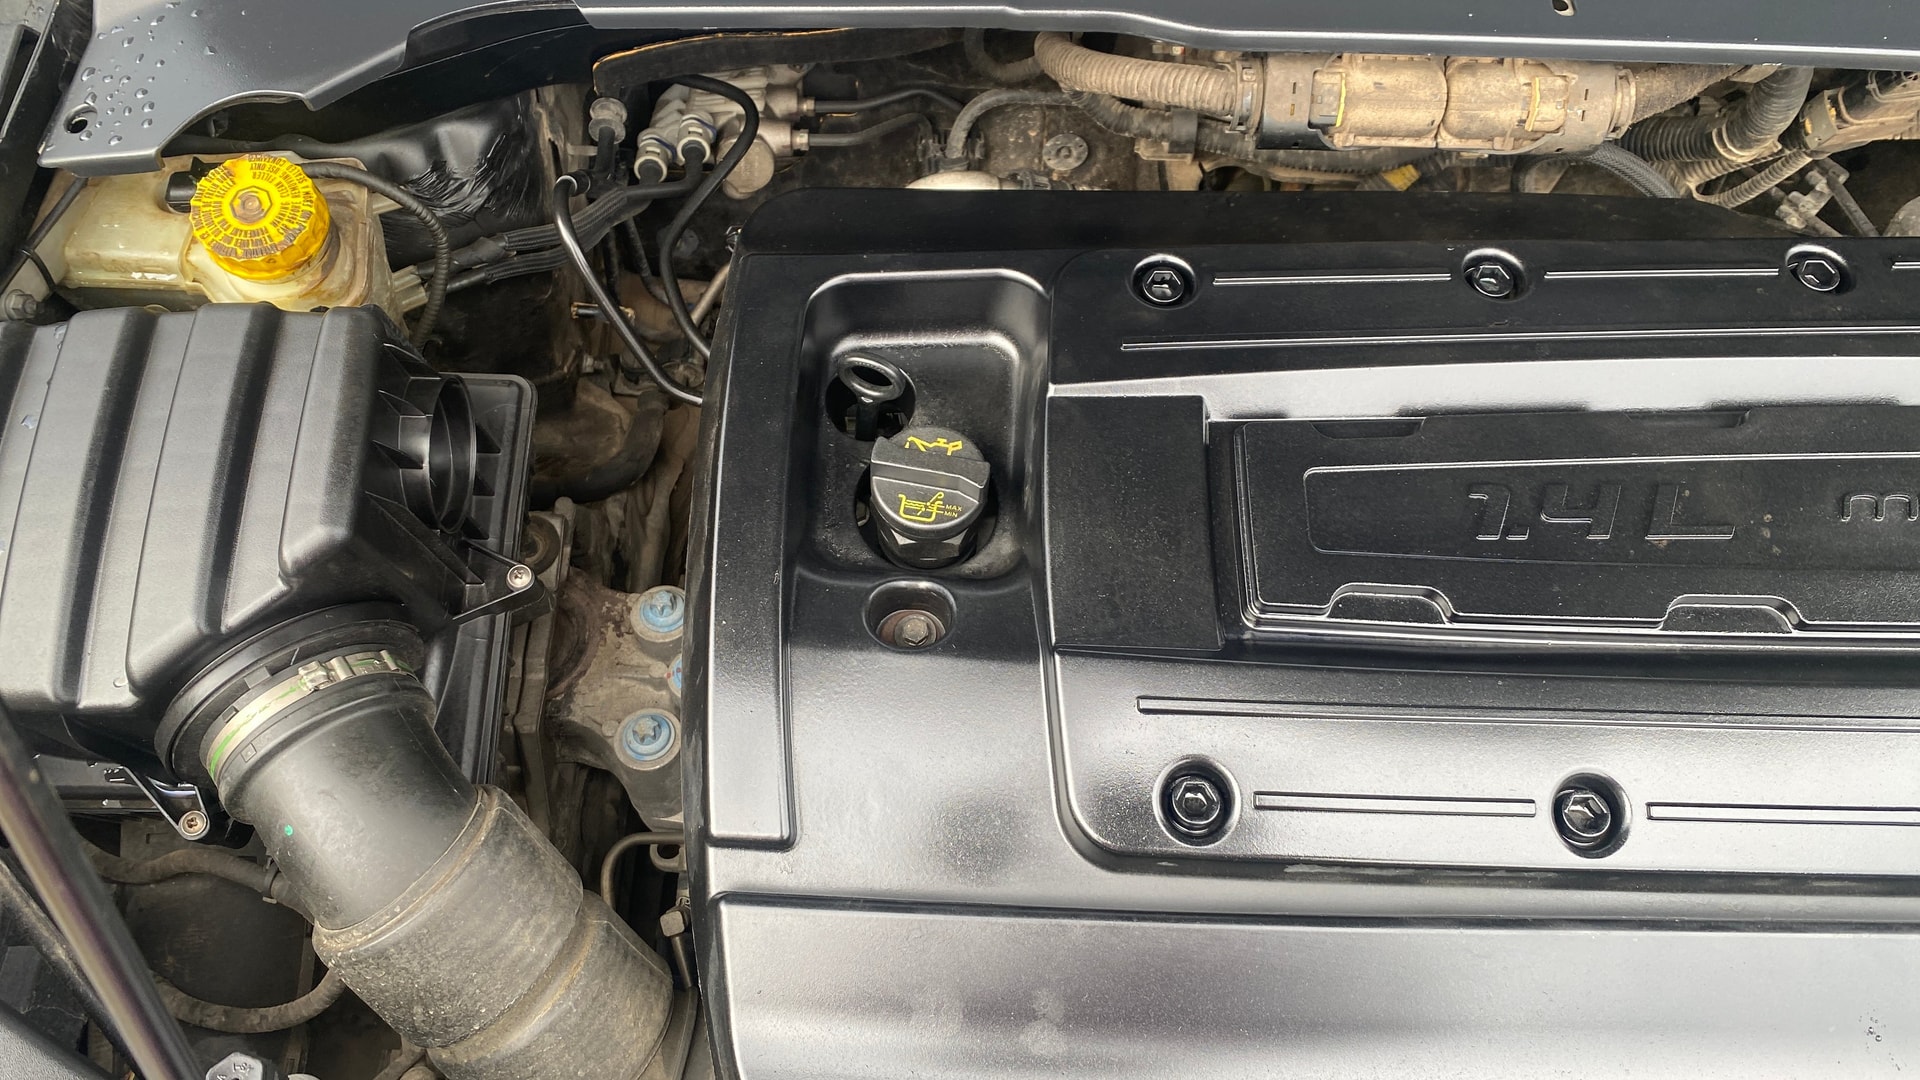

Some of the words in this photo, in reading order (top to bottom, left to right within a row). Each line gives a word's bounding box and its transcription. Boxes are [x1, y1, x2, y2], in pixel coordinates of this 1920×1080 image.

[250, 163, 266, 171] ONLY
[268, 165, 281, 175] USE
[286, 164, 307, 184] SEALED
[252, 171, 276, 183] FILLER
[192, 184, 207, 201] AVANT
[204, 183, 219, 199] FREIN
[274, 181, 290, 197] CLEAN
[302, 191, 314, 207] FROM
[285, 201, 301, 224] BEFORE
[946, 504, 963, 512] MAX
